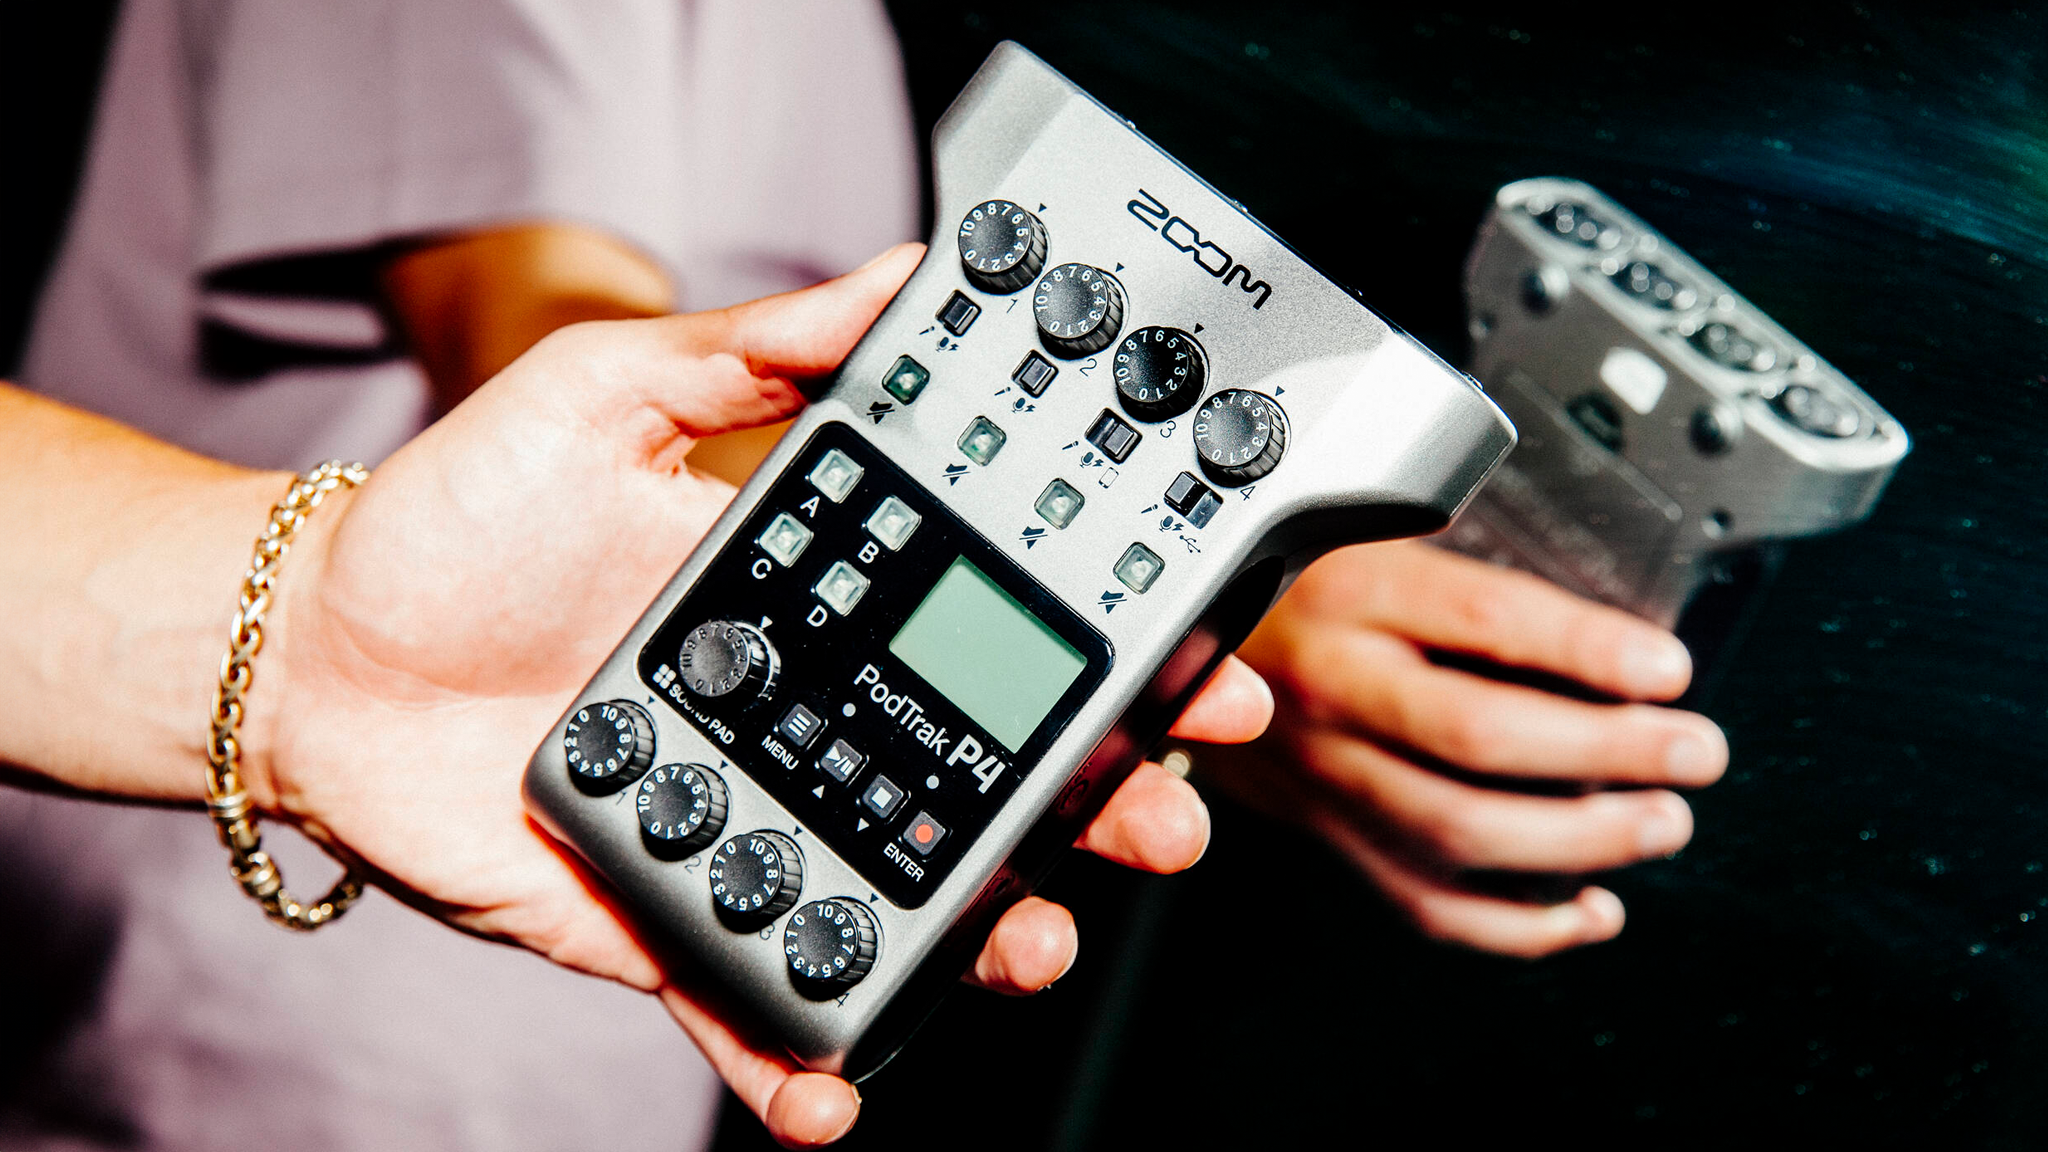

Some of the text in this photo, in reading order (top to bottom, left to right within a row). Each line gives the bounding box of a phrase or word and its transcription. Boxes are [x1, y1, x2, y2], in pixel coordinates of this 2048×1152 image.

[960, 203, 1028, 271] 0 1 2 3 4 5 6 7 8 9 10
[1127, 188, 1272, 310] ZOOM
[1006, 298, 1018, 313] 1
[1036, 266, 1105, 336] 0 1 2 3 4 5 6 7 8 9 10
[1080, 358, 1097, 377] 2
[1117, 330, 1186, 399] 0 1 2 3 4 5 6 7 8 9 10
[1160, 421, 1176, 438] 3
[1196, 392, 1268, 464] 0 1 2 3 4 5 6 7 8 9 10
[1240, 486, 1255, 501] 4
[800, 496, 820, 518] A
[858, 541, 879, 563] B
[752, 558, 772, 579] C
[807, 605, 828, 627] D
[708, 718, 735, 744] PAD
[854, 663, 1006, 794] PodTrak P4
[565, 705, 631, 776] 0 1 2 3 4 5 6 7 8 9 10
[761, 735, 799, 770] MENU
[638, 767, 705, 839] 0 1 2 3 4 5 6 7 8 9 10
[884, 843, 924, 882] ENTER
[710, 839, 778, 911] 0 1 2 3 4 5 6 7 8 9 10
[794, 914, 805, 926] 0
[817, 904, 833, 918] 10
[835, 913, 846, 925] 9
[842, 928, 853, 938] 8
[786, 944, 798, 954] 2
[842, 944, 854, 954] 7
[794, 957, 805, 969] 3
[808, 964, 817, 977] 4
[822, 964, 831, 977] 5
[834, 957, 845, 968] 6
